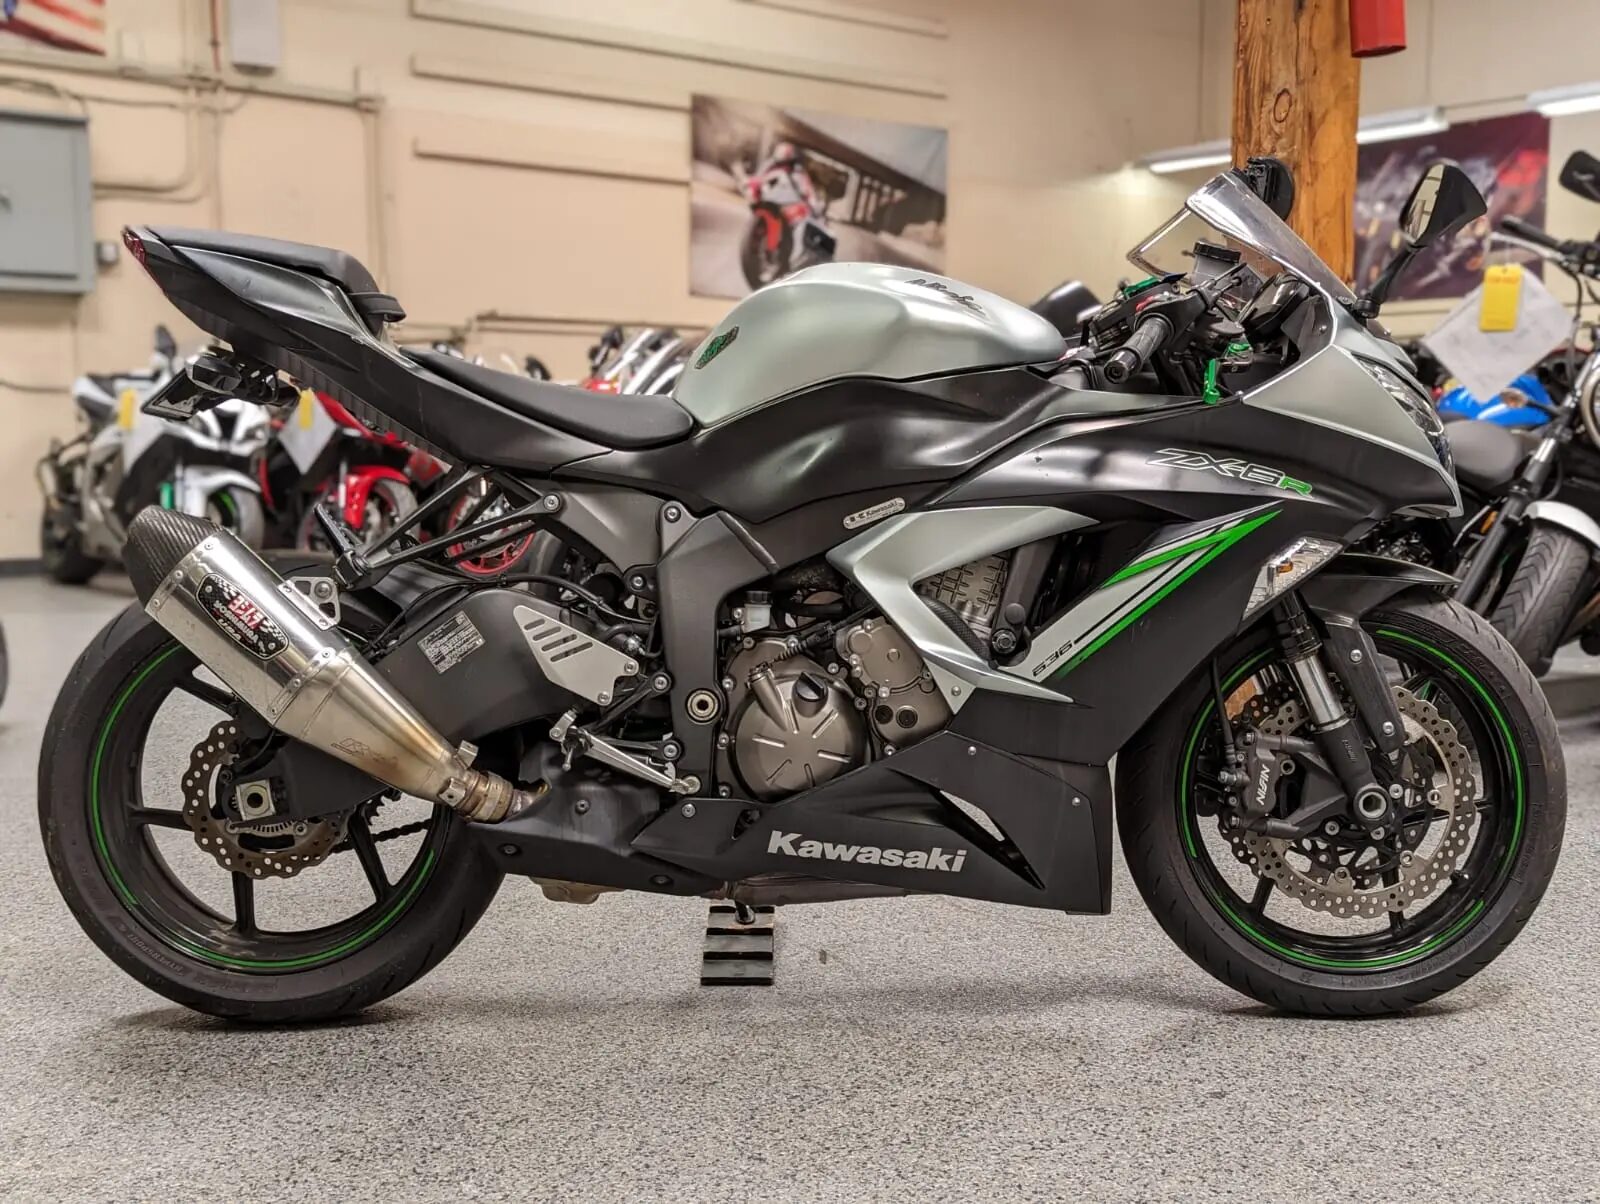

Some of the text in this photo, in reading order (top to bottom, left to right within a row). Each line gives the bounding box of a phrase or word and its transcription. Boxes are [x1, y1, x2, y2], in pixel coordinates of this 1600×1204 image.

[1146, 447, 1315, 500] ZX-6R
[1032, 640, 1073, 677] 636
[1256, 763, 1270, 806] NISSIN
[767, 830, 967, 872] Kawasaki
